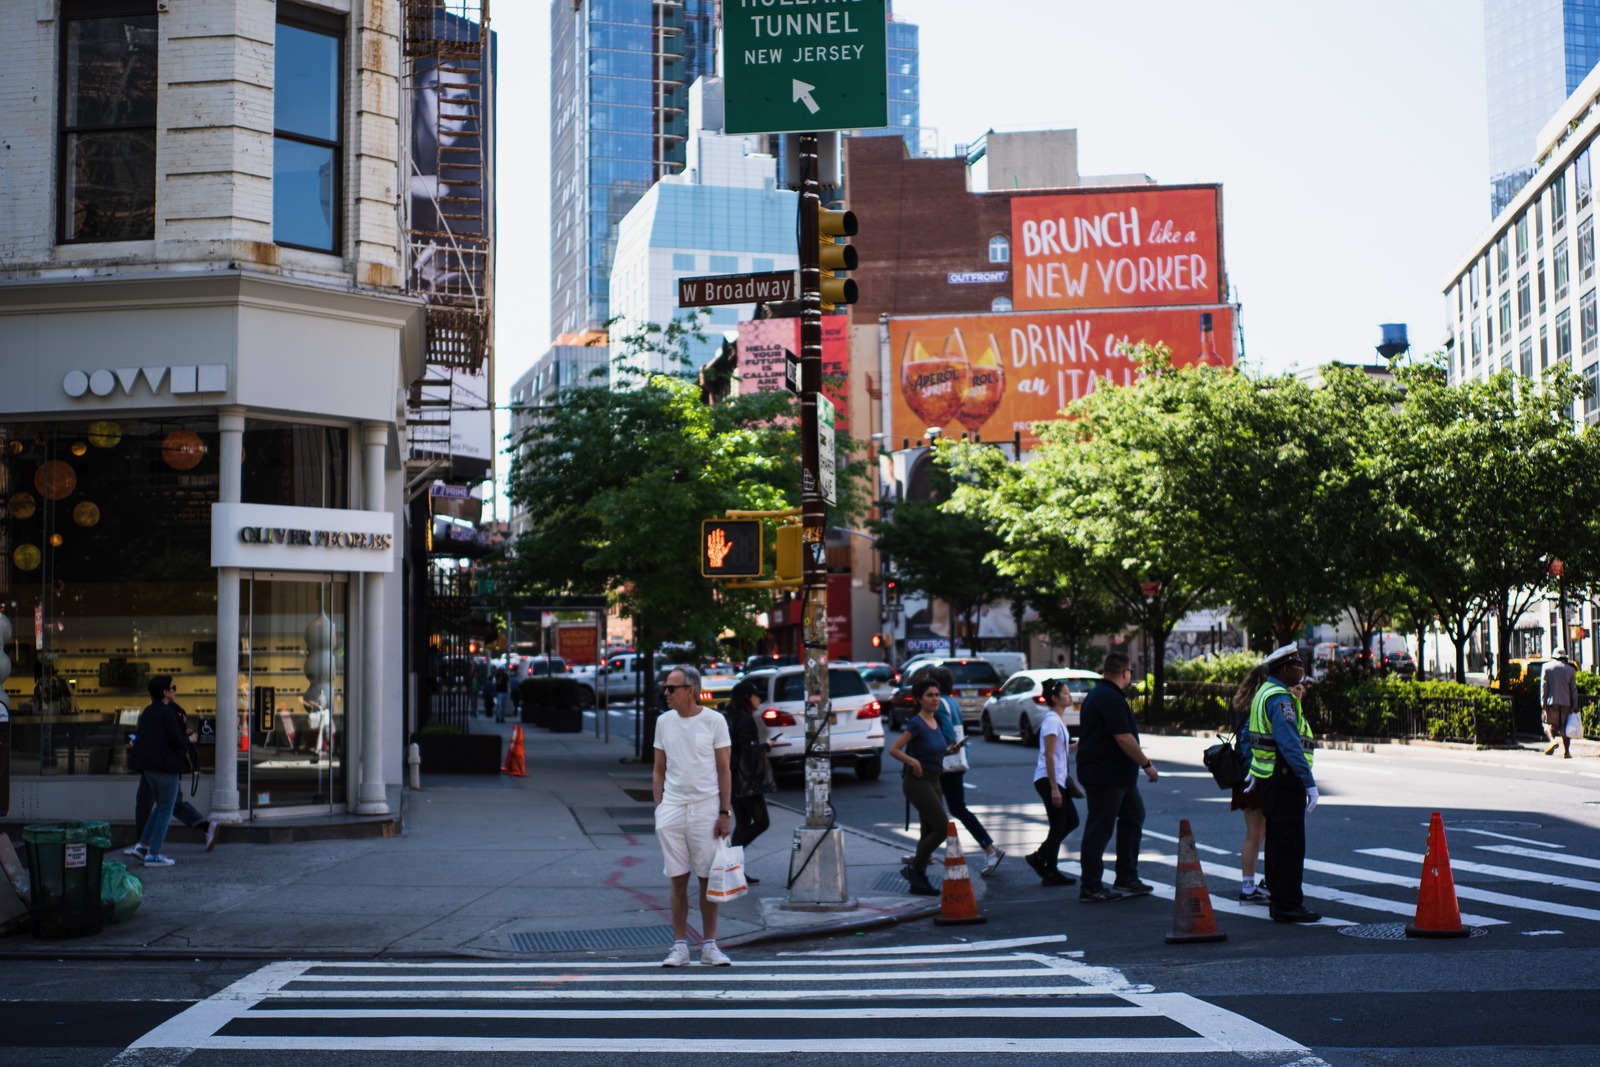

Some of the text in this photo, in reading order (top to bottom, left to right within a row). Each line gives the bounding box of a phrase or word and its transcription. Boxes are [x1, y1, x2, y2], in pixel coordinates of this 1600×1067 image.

[751, 11, 858, 37] TUNNEL
[744, 44, 865, 65] NEW JERSEY
[1022, 206, 1198, 257] BRUNCH like a
[950, 272, 1005, 282] OUTFRONT
[1026, 253, 1208, 298] NEW YORKER
[682, 278, 791, 302] W Broadway
[745, 344, 782, 352] HELLO
[1011, 319, 1099, 368] DRINK
[913, 369, 959, 391] APEROL
[921, 381, 952, 398] SPRITZ
[1018, 377, 1049, 396] an
[239, 526, 392, 550] OLIVER PEOPLES
[907, 640, 950, 649] OUTFRON
